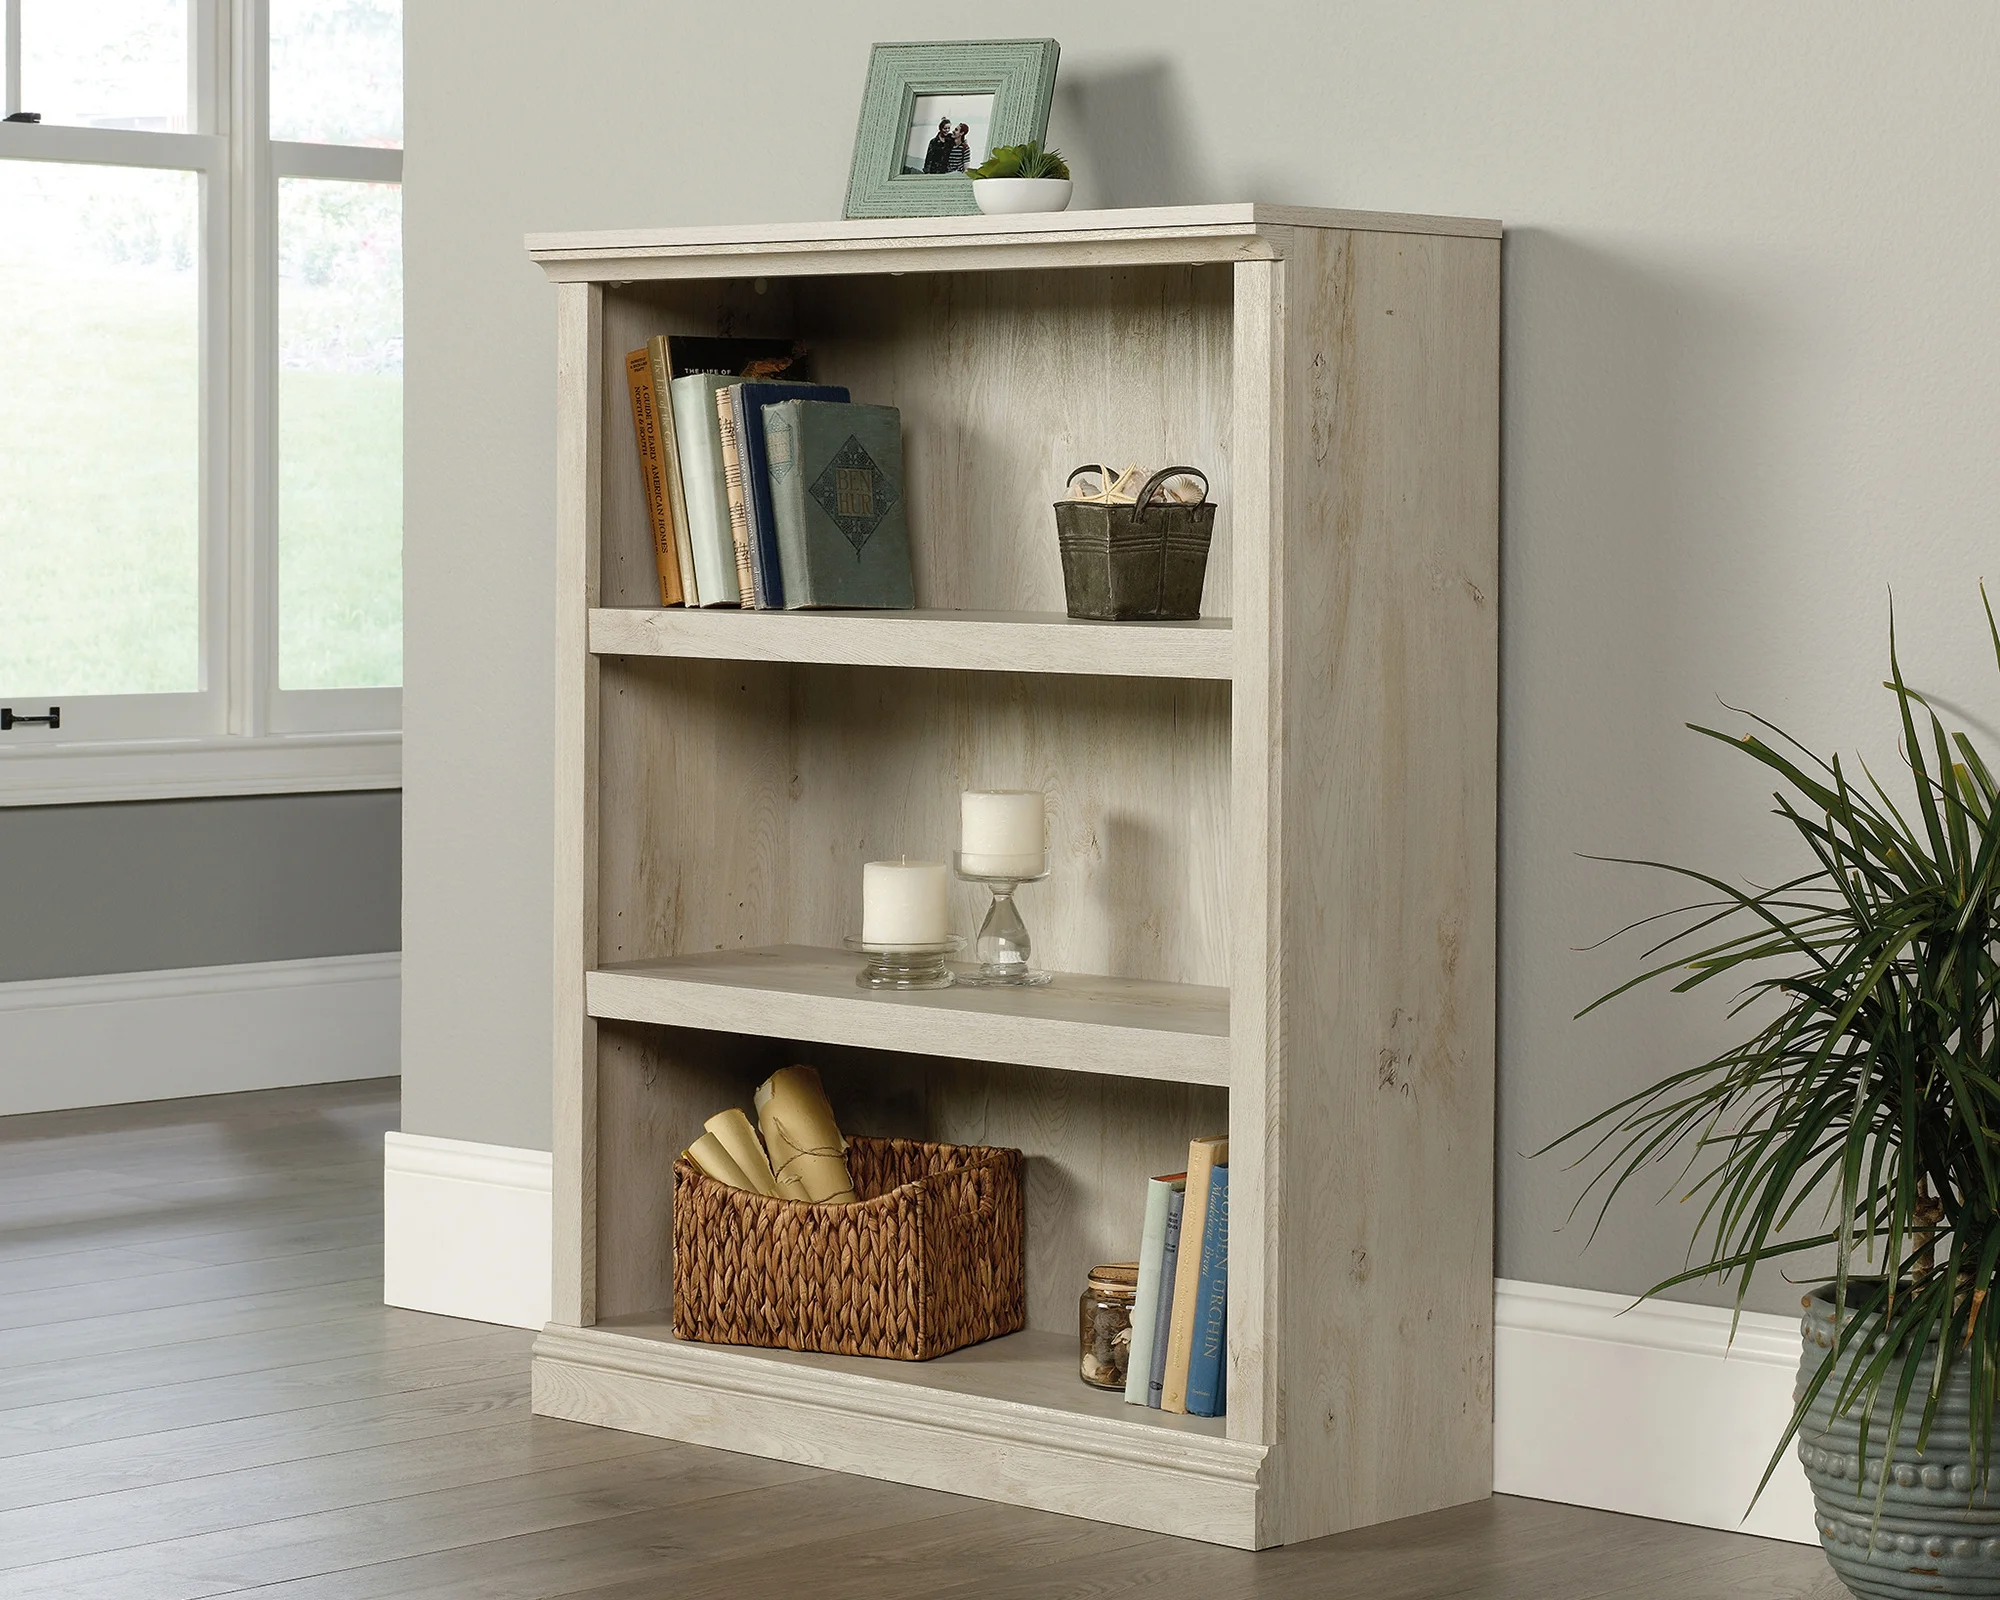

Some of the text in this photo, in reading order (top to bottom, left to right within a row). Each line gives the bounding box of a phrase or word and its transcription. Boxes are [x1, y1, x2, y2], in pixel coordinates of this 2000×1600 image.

[655, 379, 665, 397] Life
[643, 392, 652, 420] GUIDE
[658, 401, 669, 410] of
[634, 386, 643, 417] NORTH
[639, 426, 648, 456] SOUTH
[647, 421, 654, 434] TO
[647, 435, 657, 461] EARLY
[651, 464, 664, 516] AMERICAN
[837, 469, 872, 492] BEN
[838, 493, 874, 515] HUR
[658, 519, 669, 554] HOMES
[1202, 1182, 1221, 1277] Madeleine Brent
[1203, 1279, 1226, 1360] URCHIN
